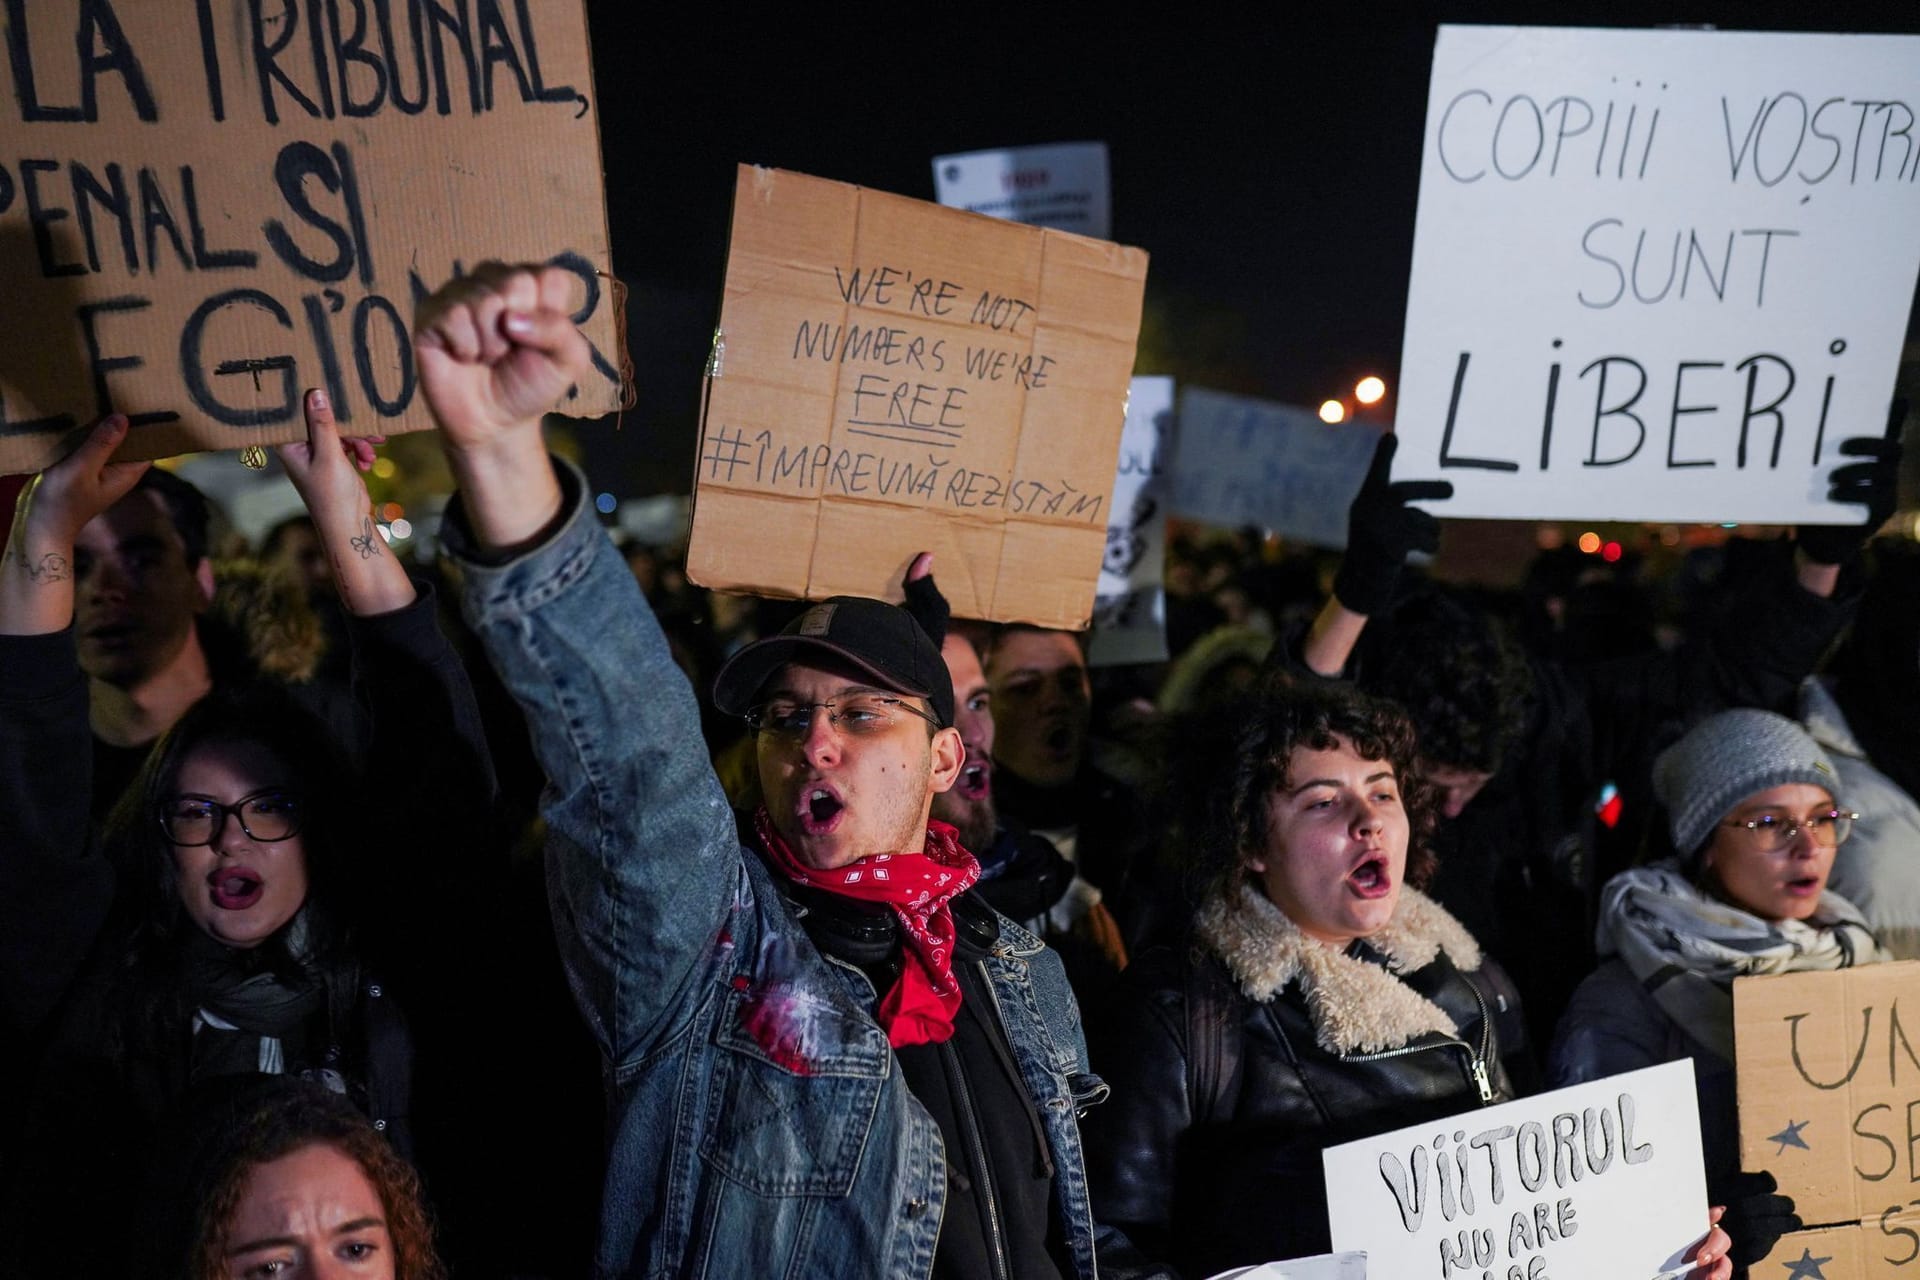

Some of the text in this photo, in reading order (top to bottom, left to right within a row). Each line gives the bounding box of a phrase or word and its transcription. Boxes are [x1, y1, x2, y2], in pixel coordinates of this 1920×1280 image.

[4, 0, 158, 123] LA
[1577, 217, 1800, 310] SUNT
[834, 266, 1036, 333] WE'RE NOT
[792, 320, 1057, 391] NUMBERS WE'RE
[853, 374, 968, 427] FREE
[1440, 1228, 1495, 1280] NU
[1508, 1197, 1579, 1259] ARE
[1879, 1199, 1920, 1266] S
